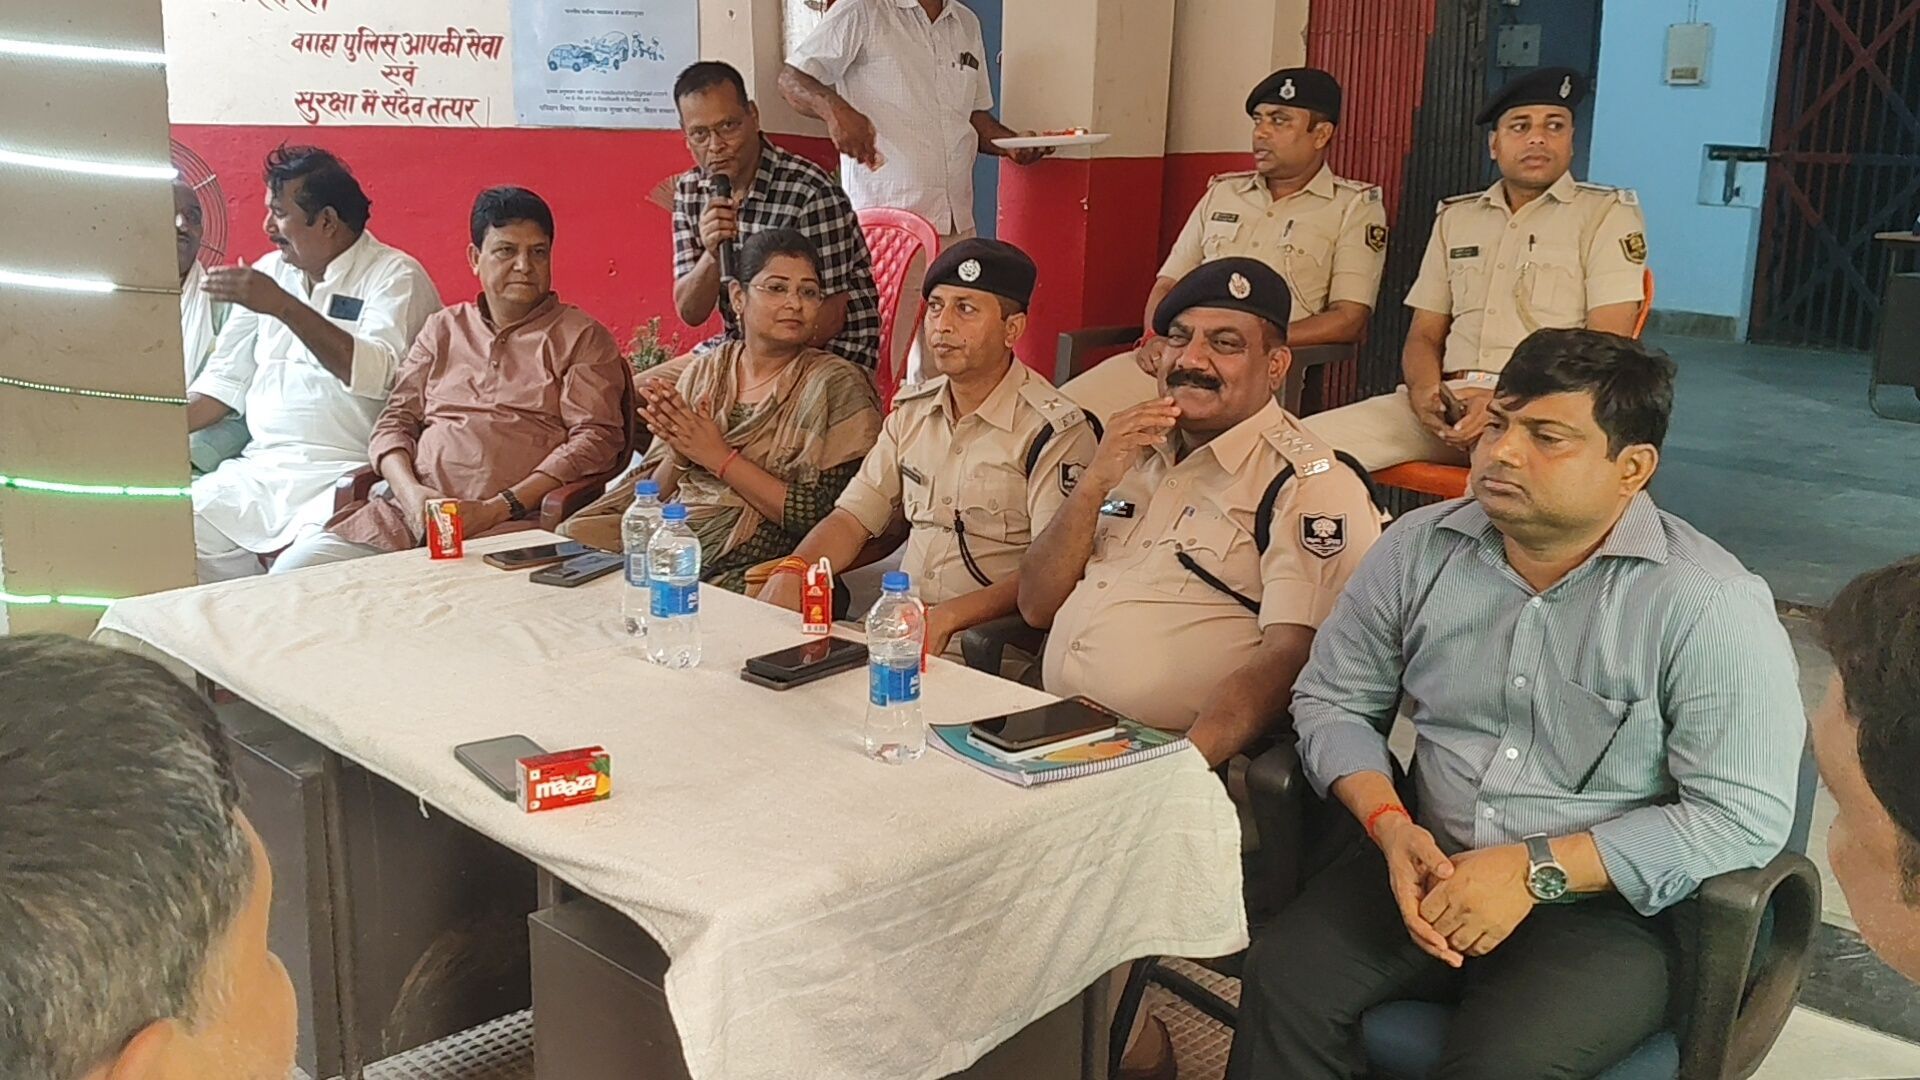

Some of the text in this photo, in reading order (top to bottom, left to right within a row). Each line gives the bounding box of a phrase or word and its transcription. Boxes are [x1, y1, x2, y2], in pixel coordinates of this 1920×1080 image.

[343, 26, 400, 62] पुलिस
[401, 26, 465, 58] आपकी
[466, 28, 504, 61] सेवा
[294, 91, 359, 125] सुरक्षा
[361, 90, 380, 115] में
[535, 774, 597, 799] maaza
